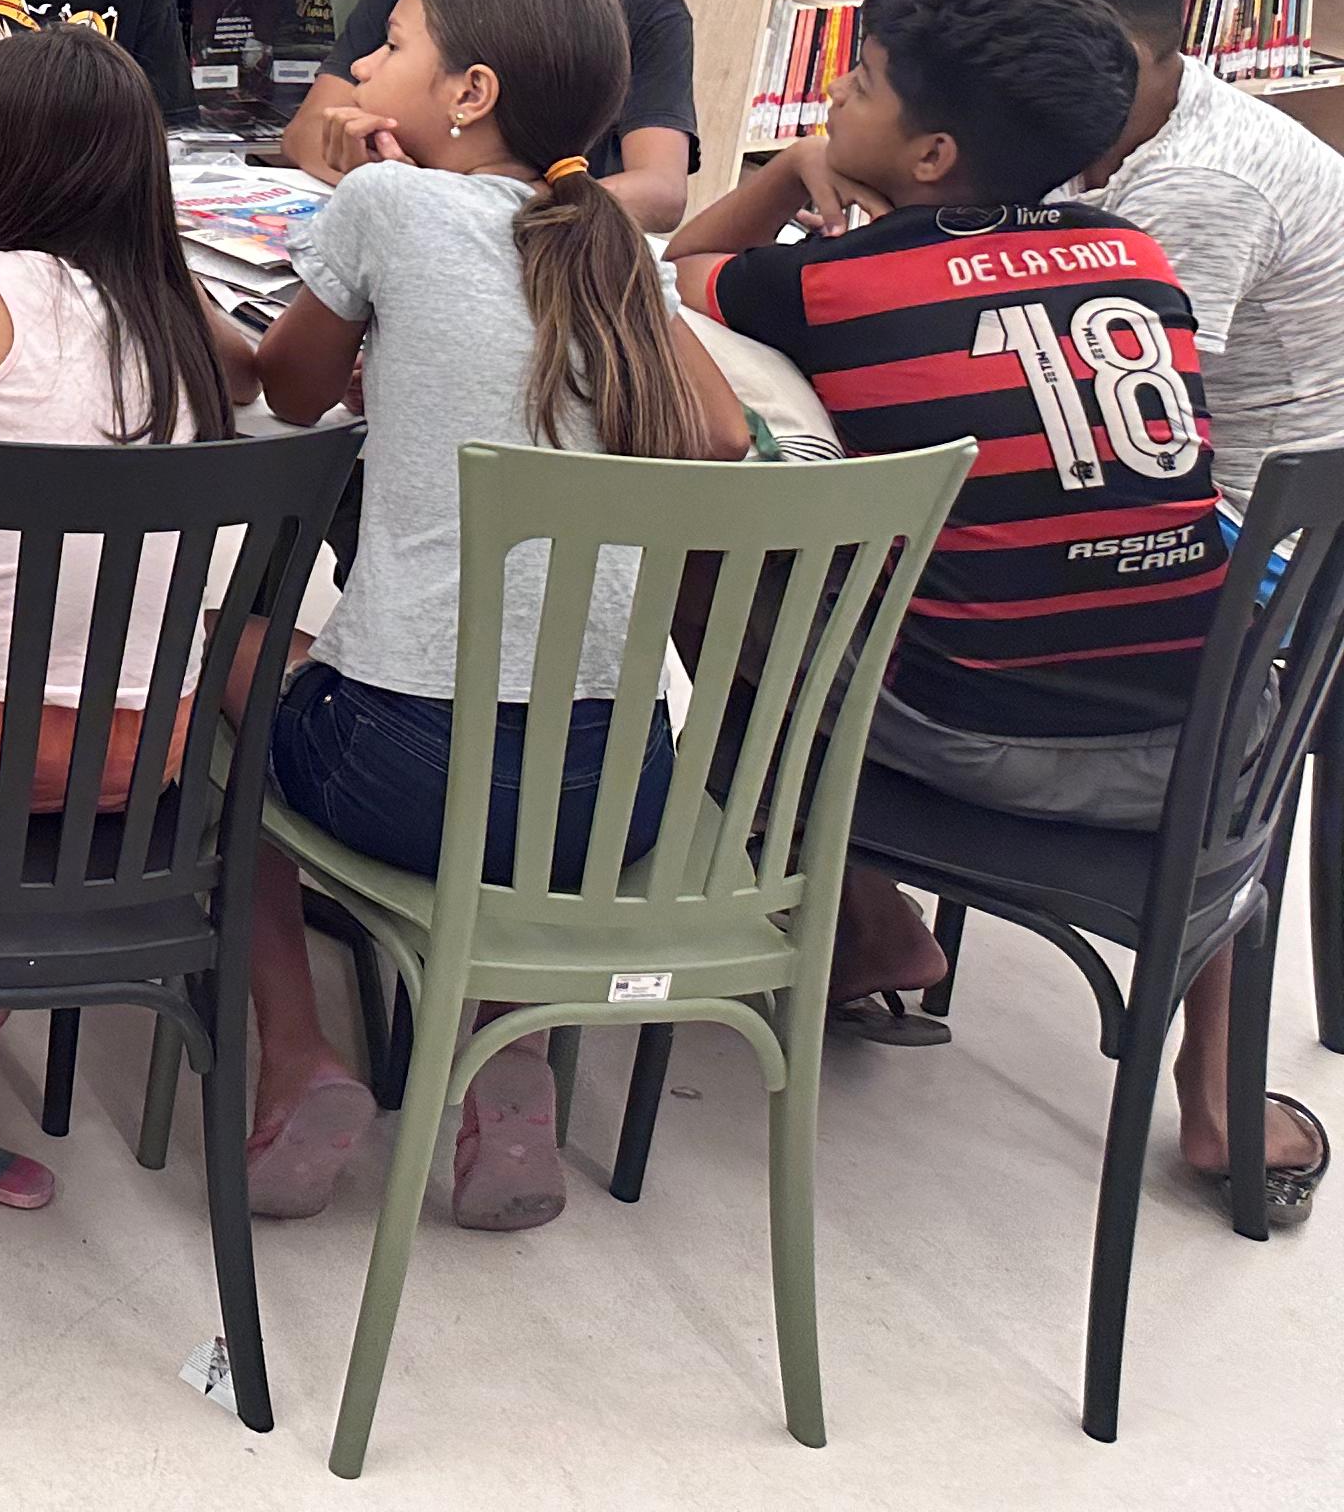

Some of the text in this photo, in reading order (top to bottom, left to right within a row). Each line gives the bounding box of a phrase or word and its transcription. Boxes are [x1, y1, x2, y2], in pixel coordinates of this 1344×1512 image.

[1016, 205, 1061, 225] livre
[948, 240, 1137, 286] DE LA CRUZ
[971, 297, 1203, 492] 18
[1067, 525, 1197, 562] ASSIST
[1117, 541, 1207, 575] CARD
